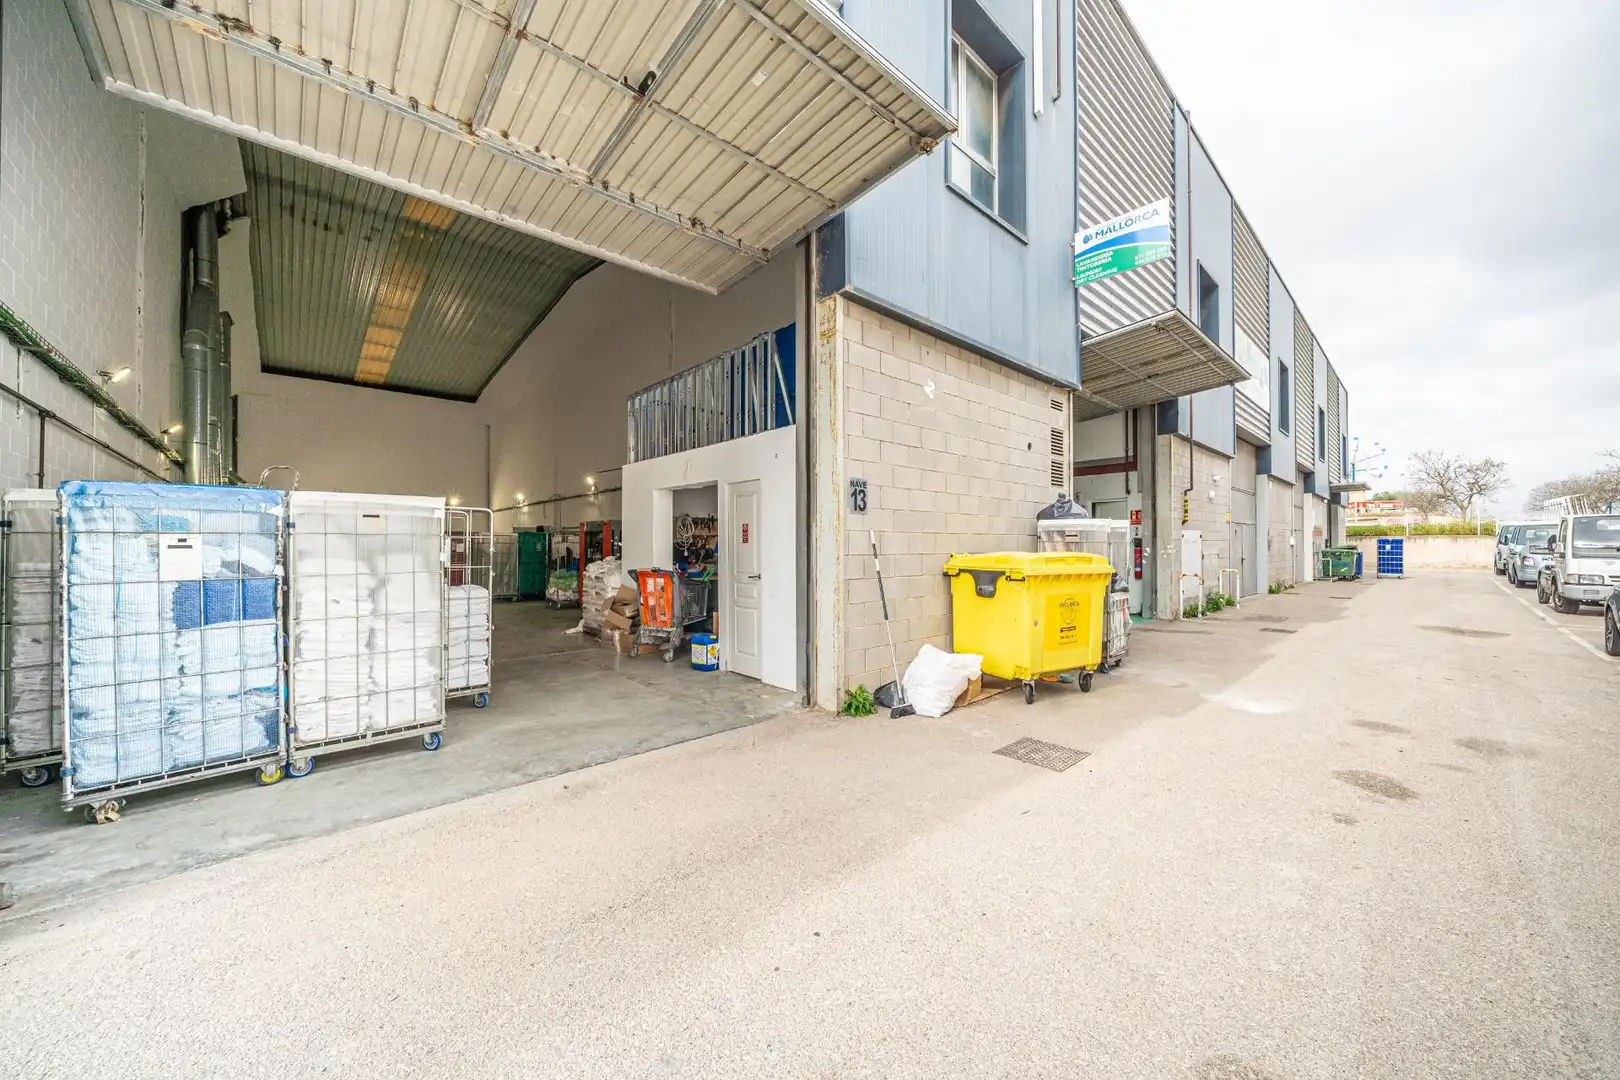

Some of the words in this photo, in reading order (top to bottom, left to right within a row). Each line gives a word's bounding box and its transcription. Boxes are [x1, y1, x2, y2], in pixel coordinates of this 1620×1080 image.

[1095, 208, 1160, 239] MALLORCA
[850, 480, 867, 489] NAVE
[851, 488, 867, 511] 13
